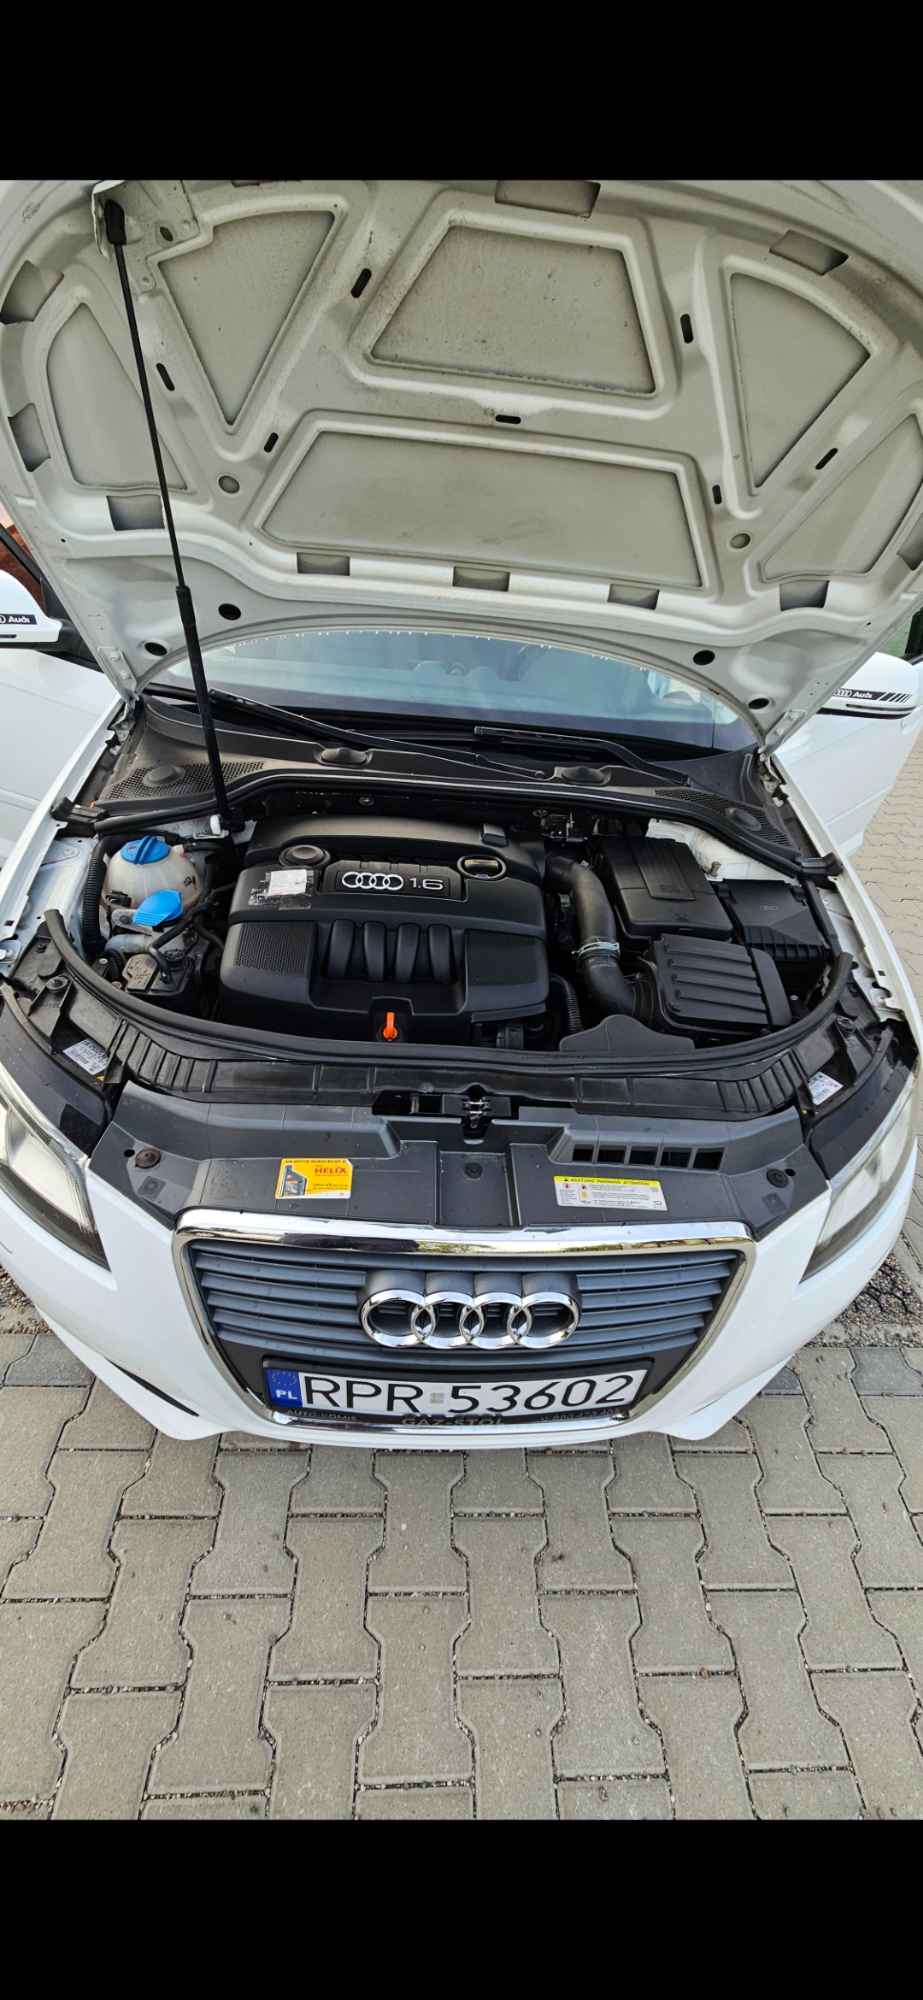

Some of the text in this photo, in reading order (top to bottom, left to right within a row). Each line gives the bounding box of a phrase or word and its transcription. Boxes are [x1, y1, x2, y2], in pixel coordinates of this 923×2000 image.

[853, 691, 872, 699] Audi
[409, 877, 443, 890] 1.6
[314, 1167, 346, 1175] HELIX
[275, 1389, 298, 1400] PL
[304, 1374, 635, 1413] RPR 53602
